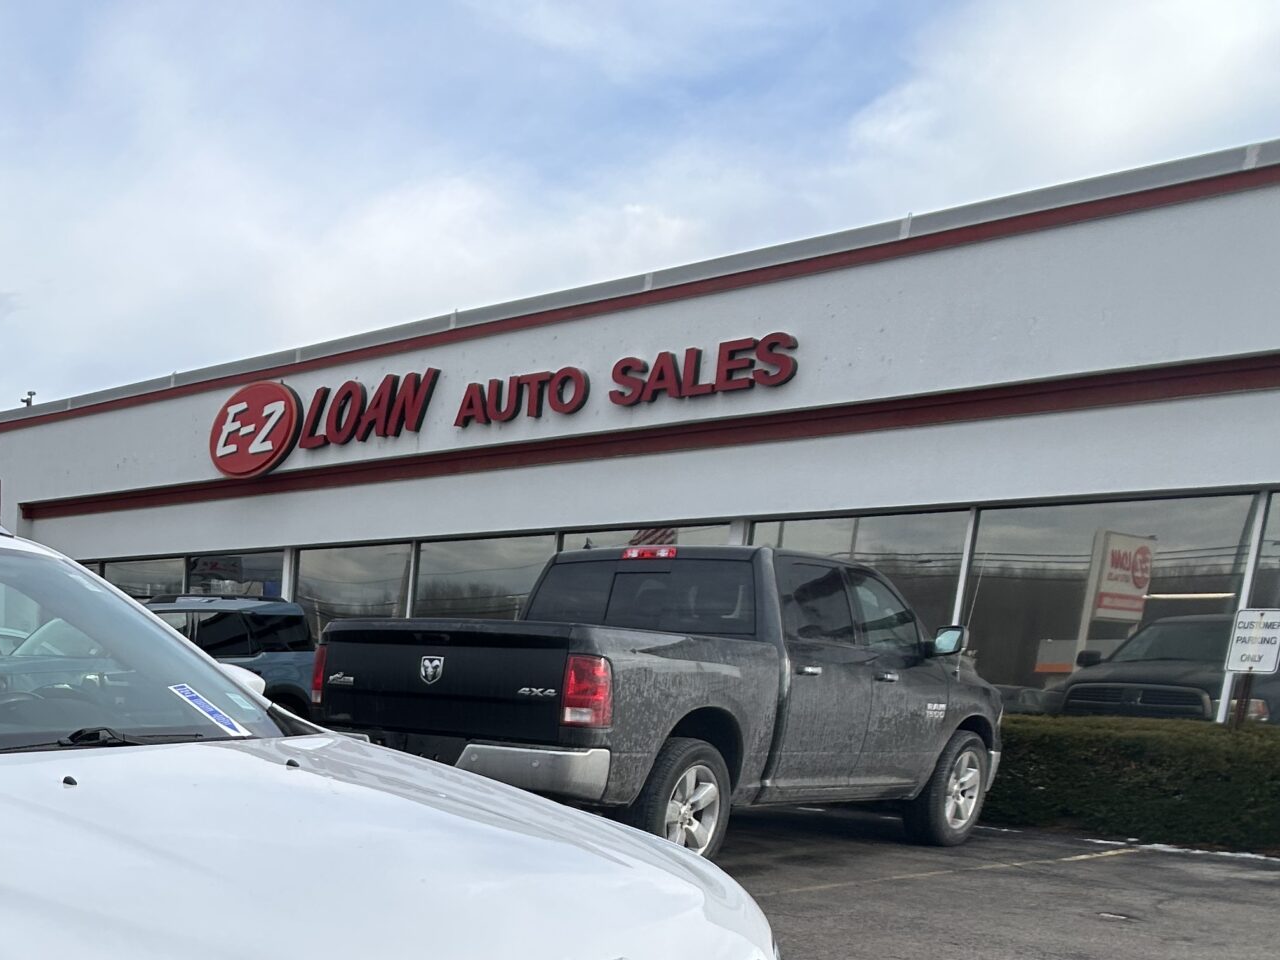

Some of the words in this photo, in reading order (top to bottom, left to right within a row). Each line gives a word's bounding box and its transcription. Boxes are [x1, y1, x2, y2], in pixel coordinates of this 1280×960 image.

[216, 400, 285, 457] E-Z
[298, 367, 440, 450] LOAN
[454, 366, 590, 428] AUTO
[609, 332, 798, 407] SALES
[1240, 653, 1264, 662] ONLY
[517, 687, 558, 697] 4X4
[927, 702, 947, 711] RAM
